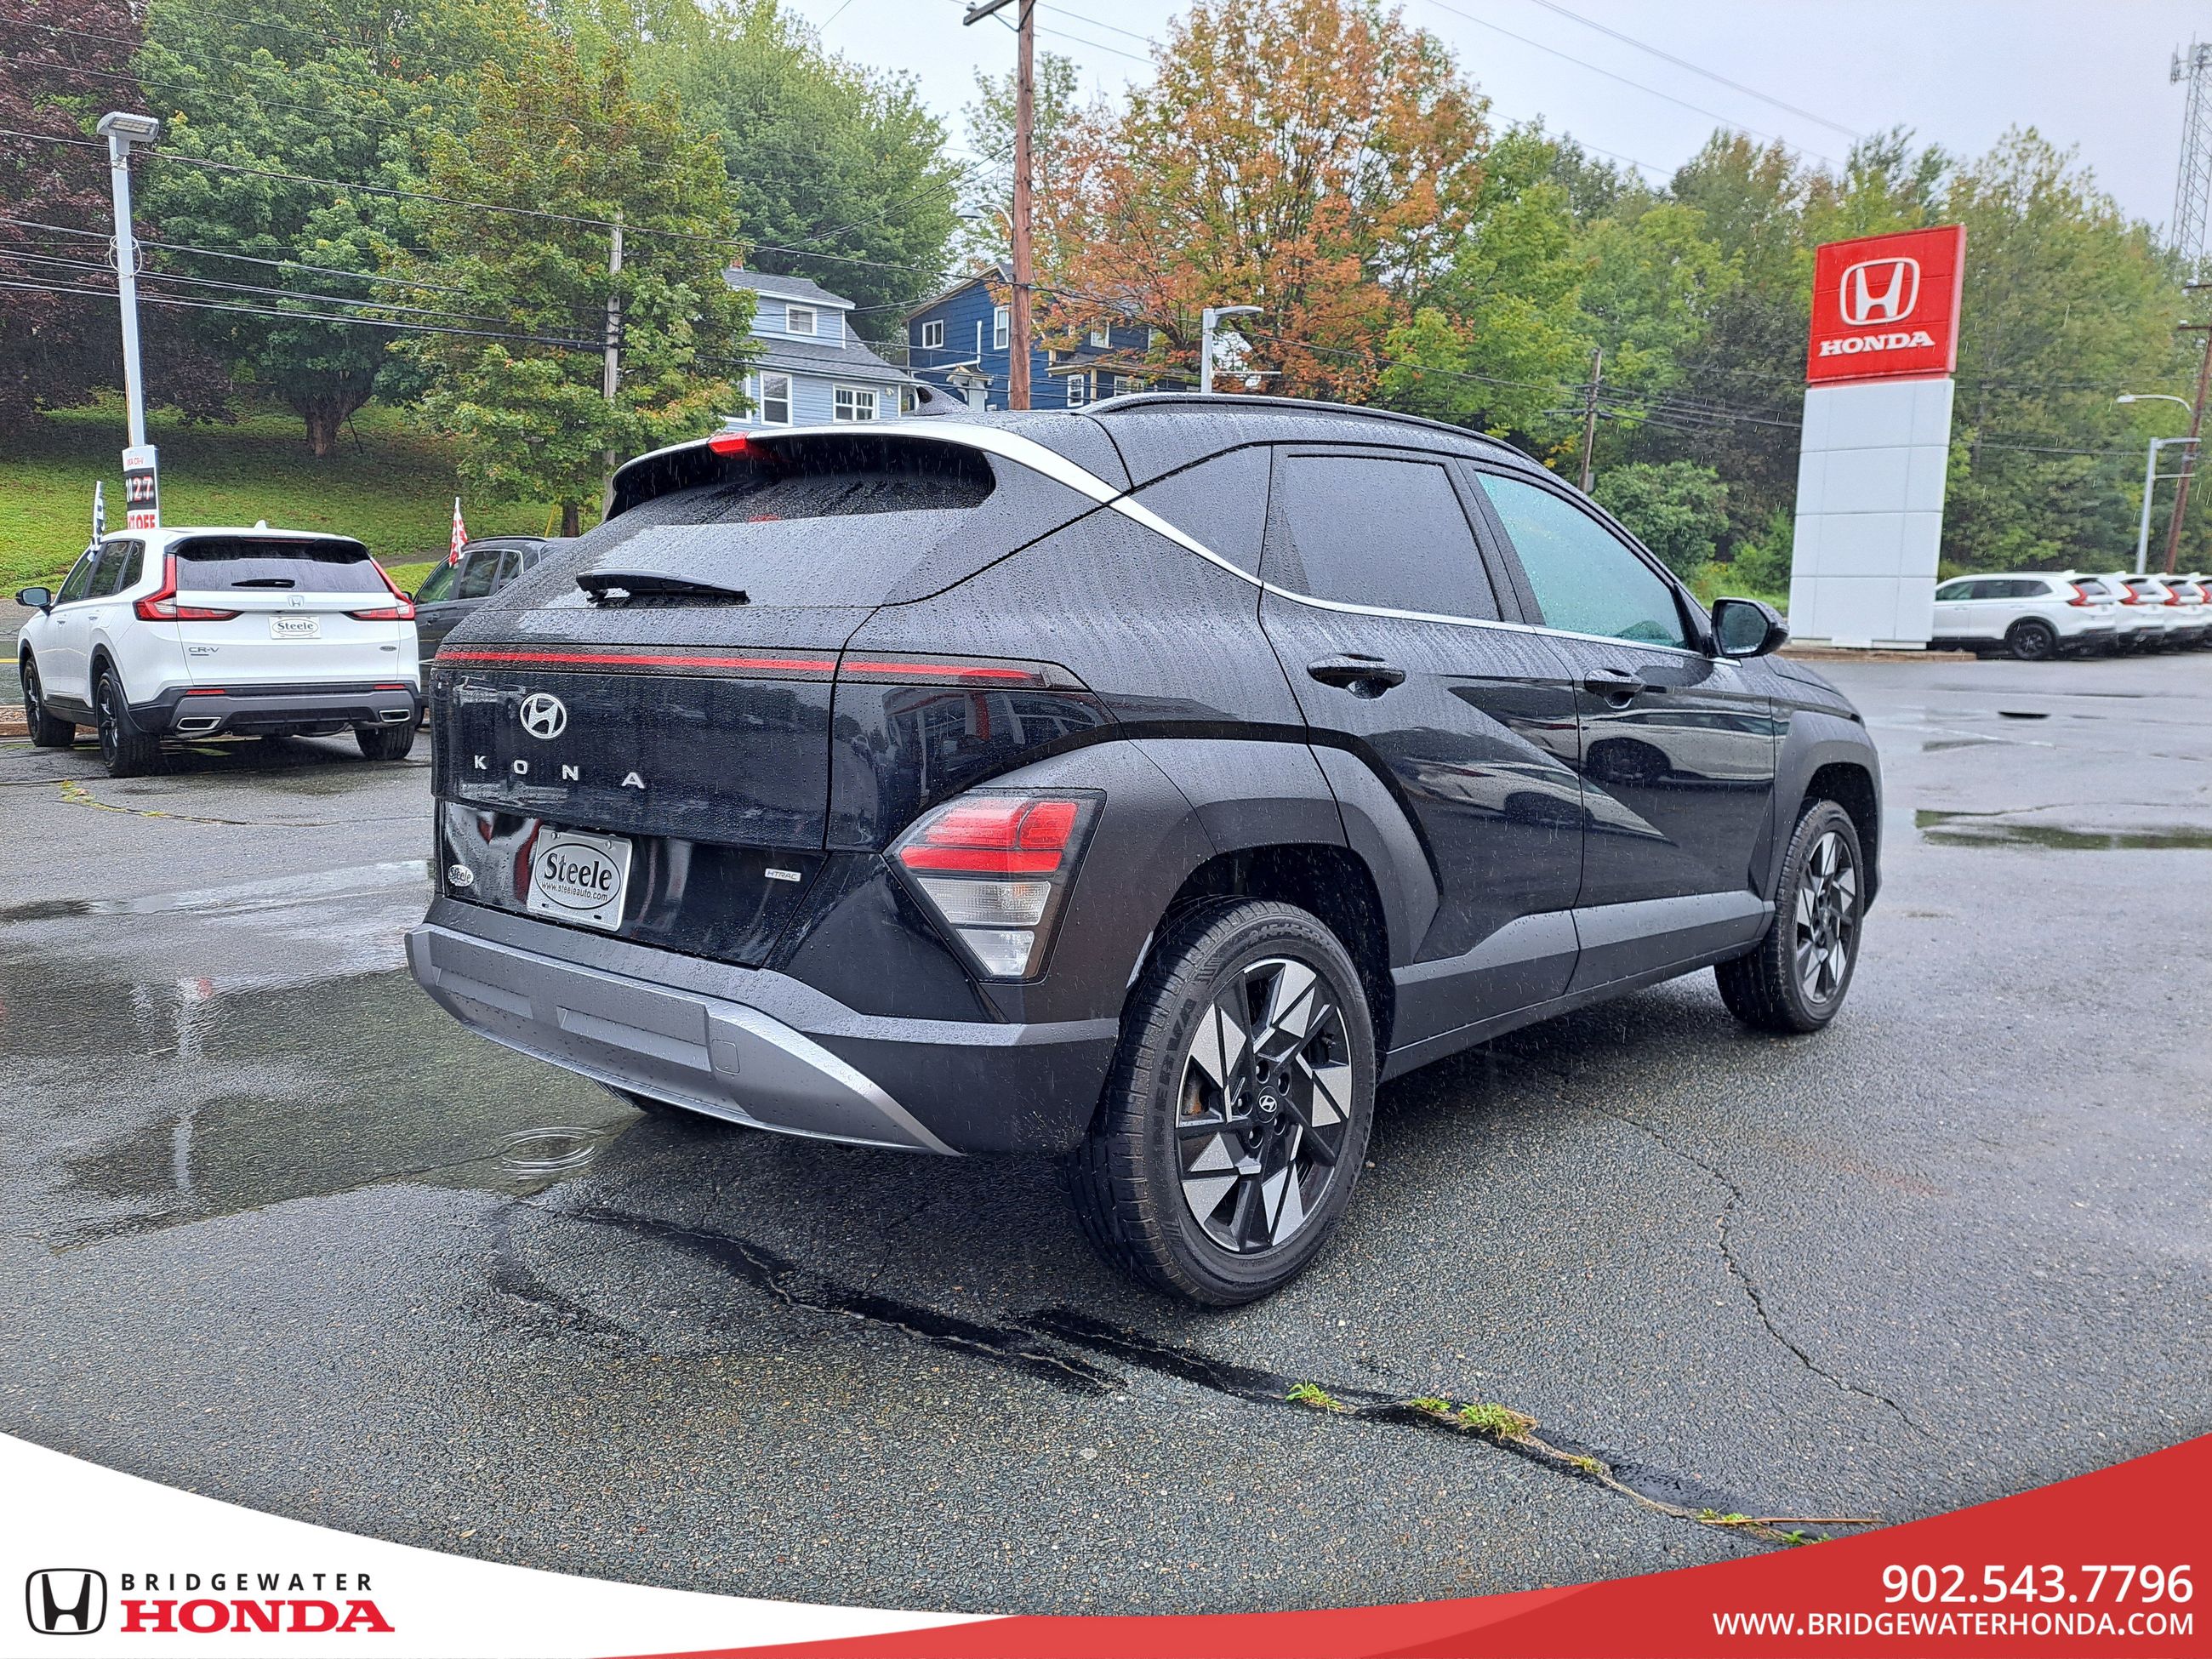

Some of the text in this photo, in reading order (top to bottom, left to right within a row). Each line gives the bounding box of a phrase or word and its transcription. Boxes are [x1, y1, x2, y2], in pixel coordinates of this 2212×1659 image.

[1818, 331, 1935, 358] HONDA
[277, 622, 314, 630] Steele
[474, 755, 645, 789] KONA
[449, 866, 471, 883] Steele
[544, 852, 613, 891] Steele
[767, 870, 798, 880] HTRAC
[541, 881, 608, 901] www.steeleauto.com
